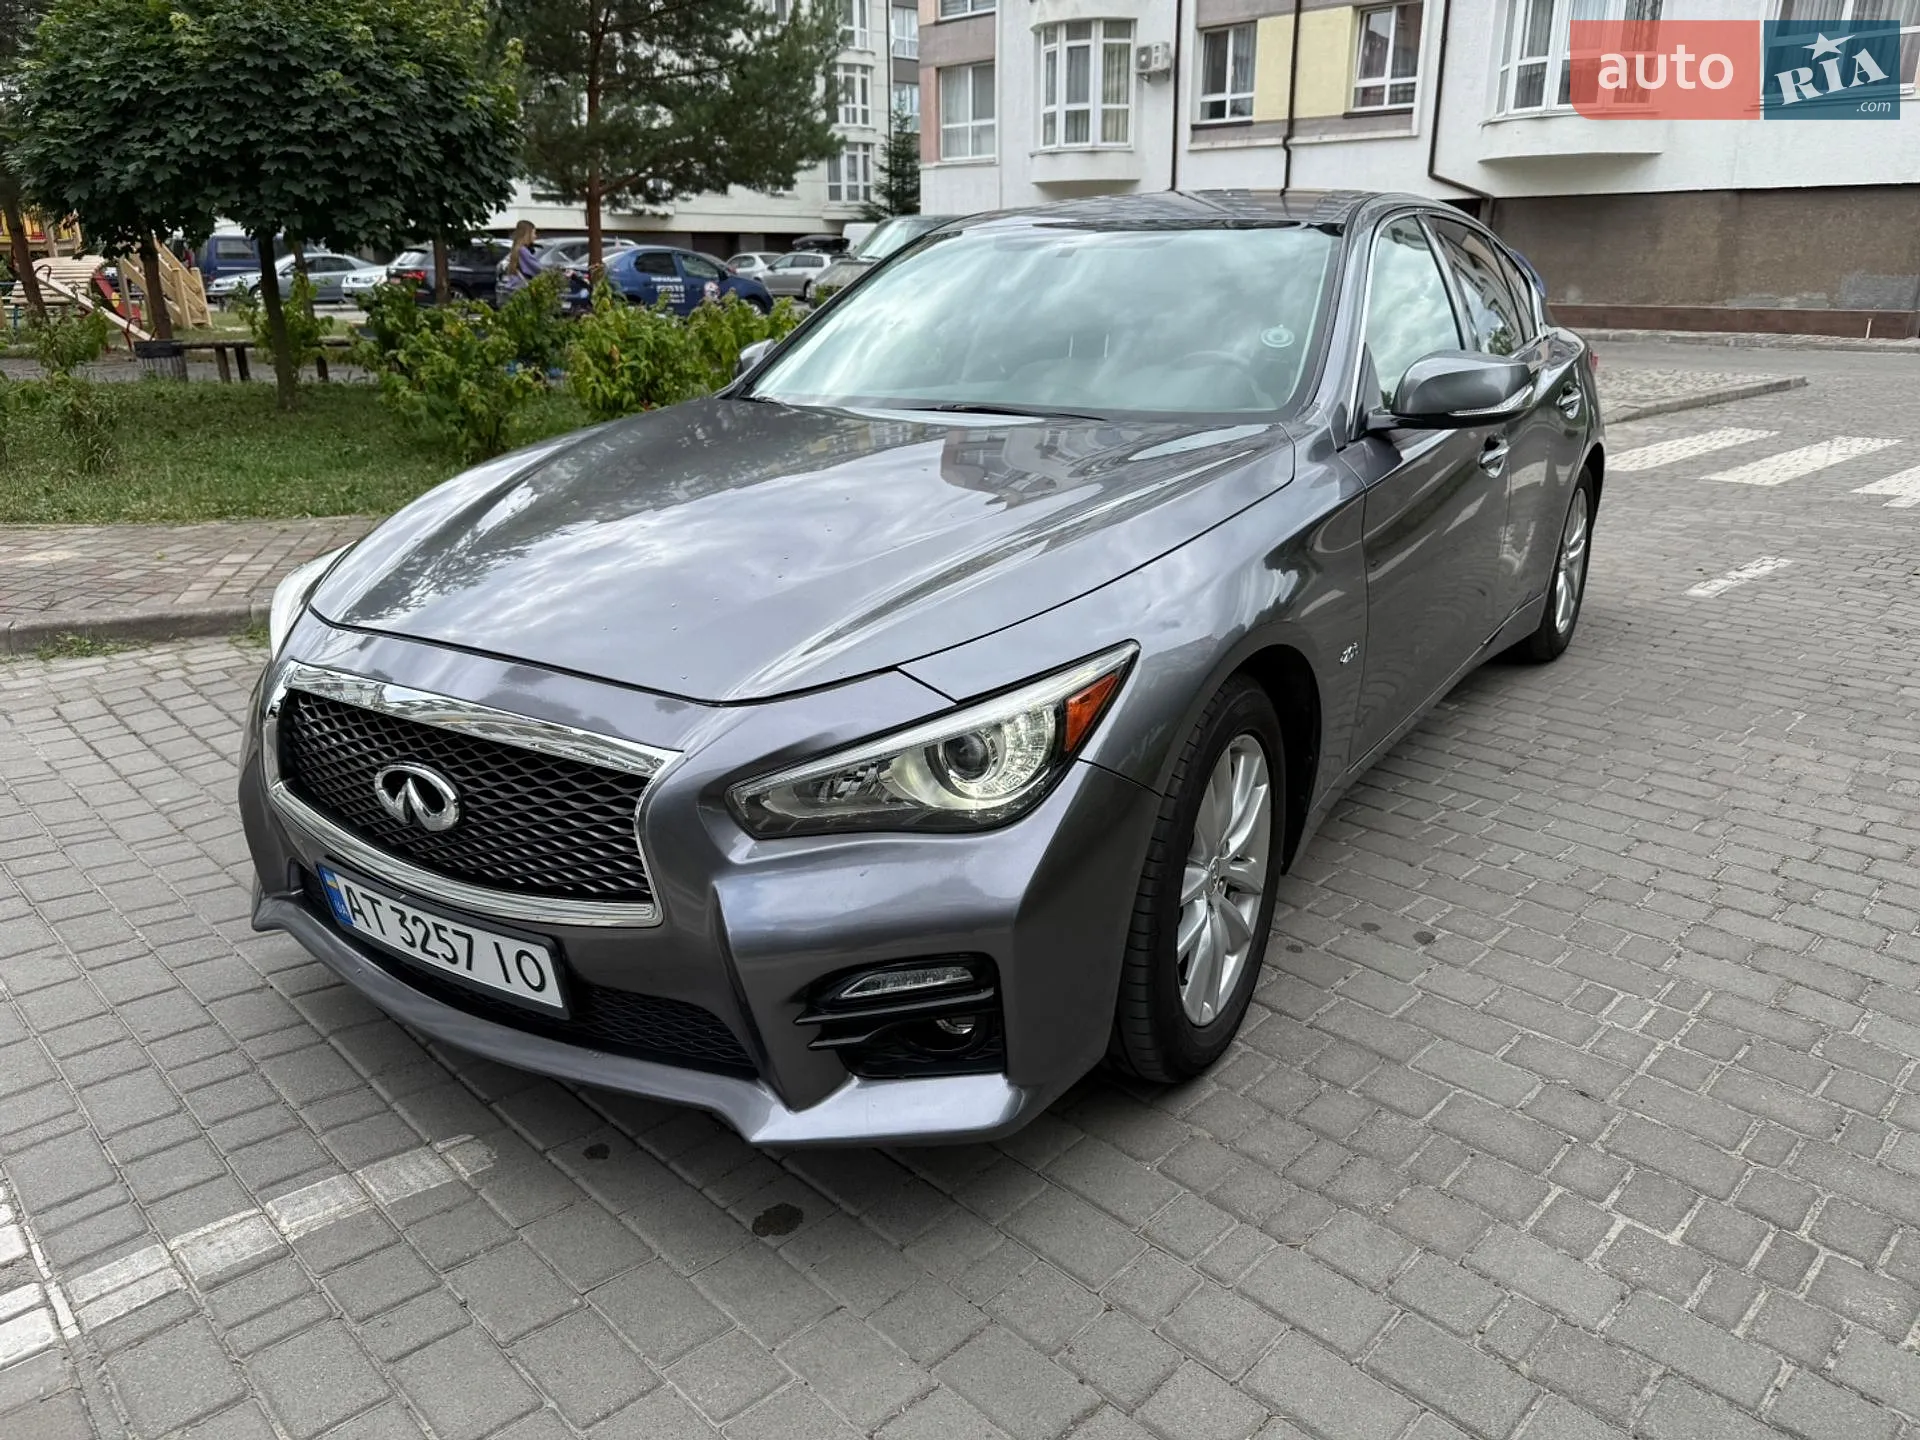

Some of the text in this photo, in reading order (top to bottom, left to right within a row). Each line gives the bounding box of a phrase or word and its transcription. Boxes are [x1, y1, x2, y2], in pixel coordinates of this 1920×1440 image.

[344, 884, 547, 993] AT 3257 IO
